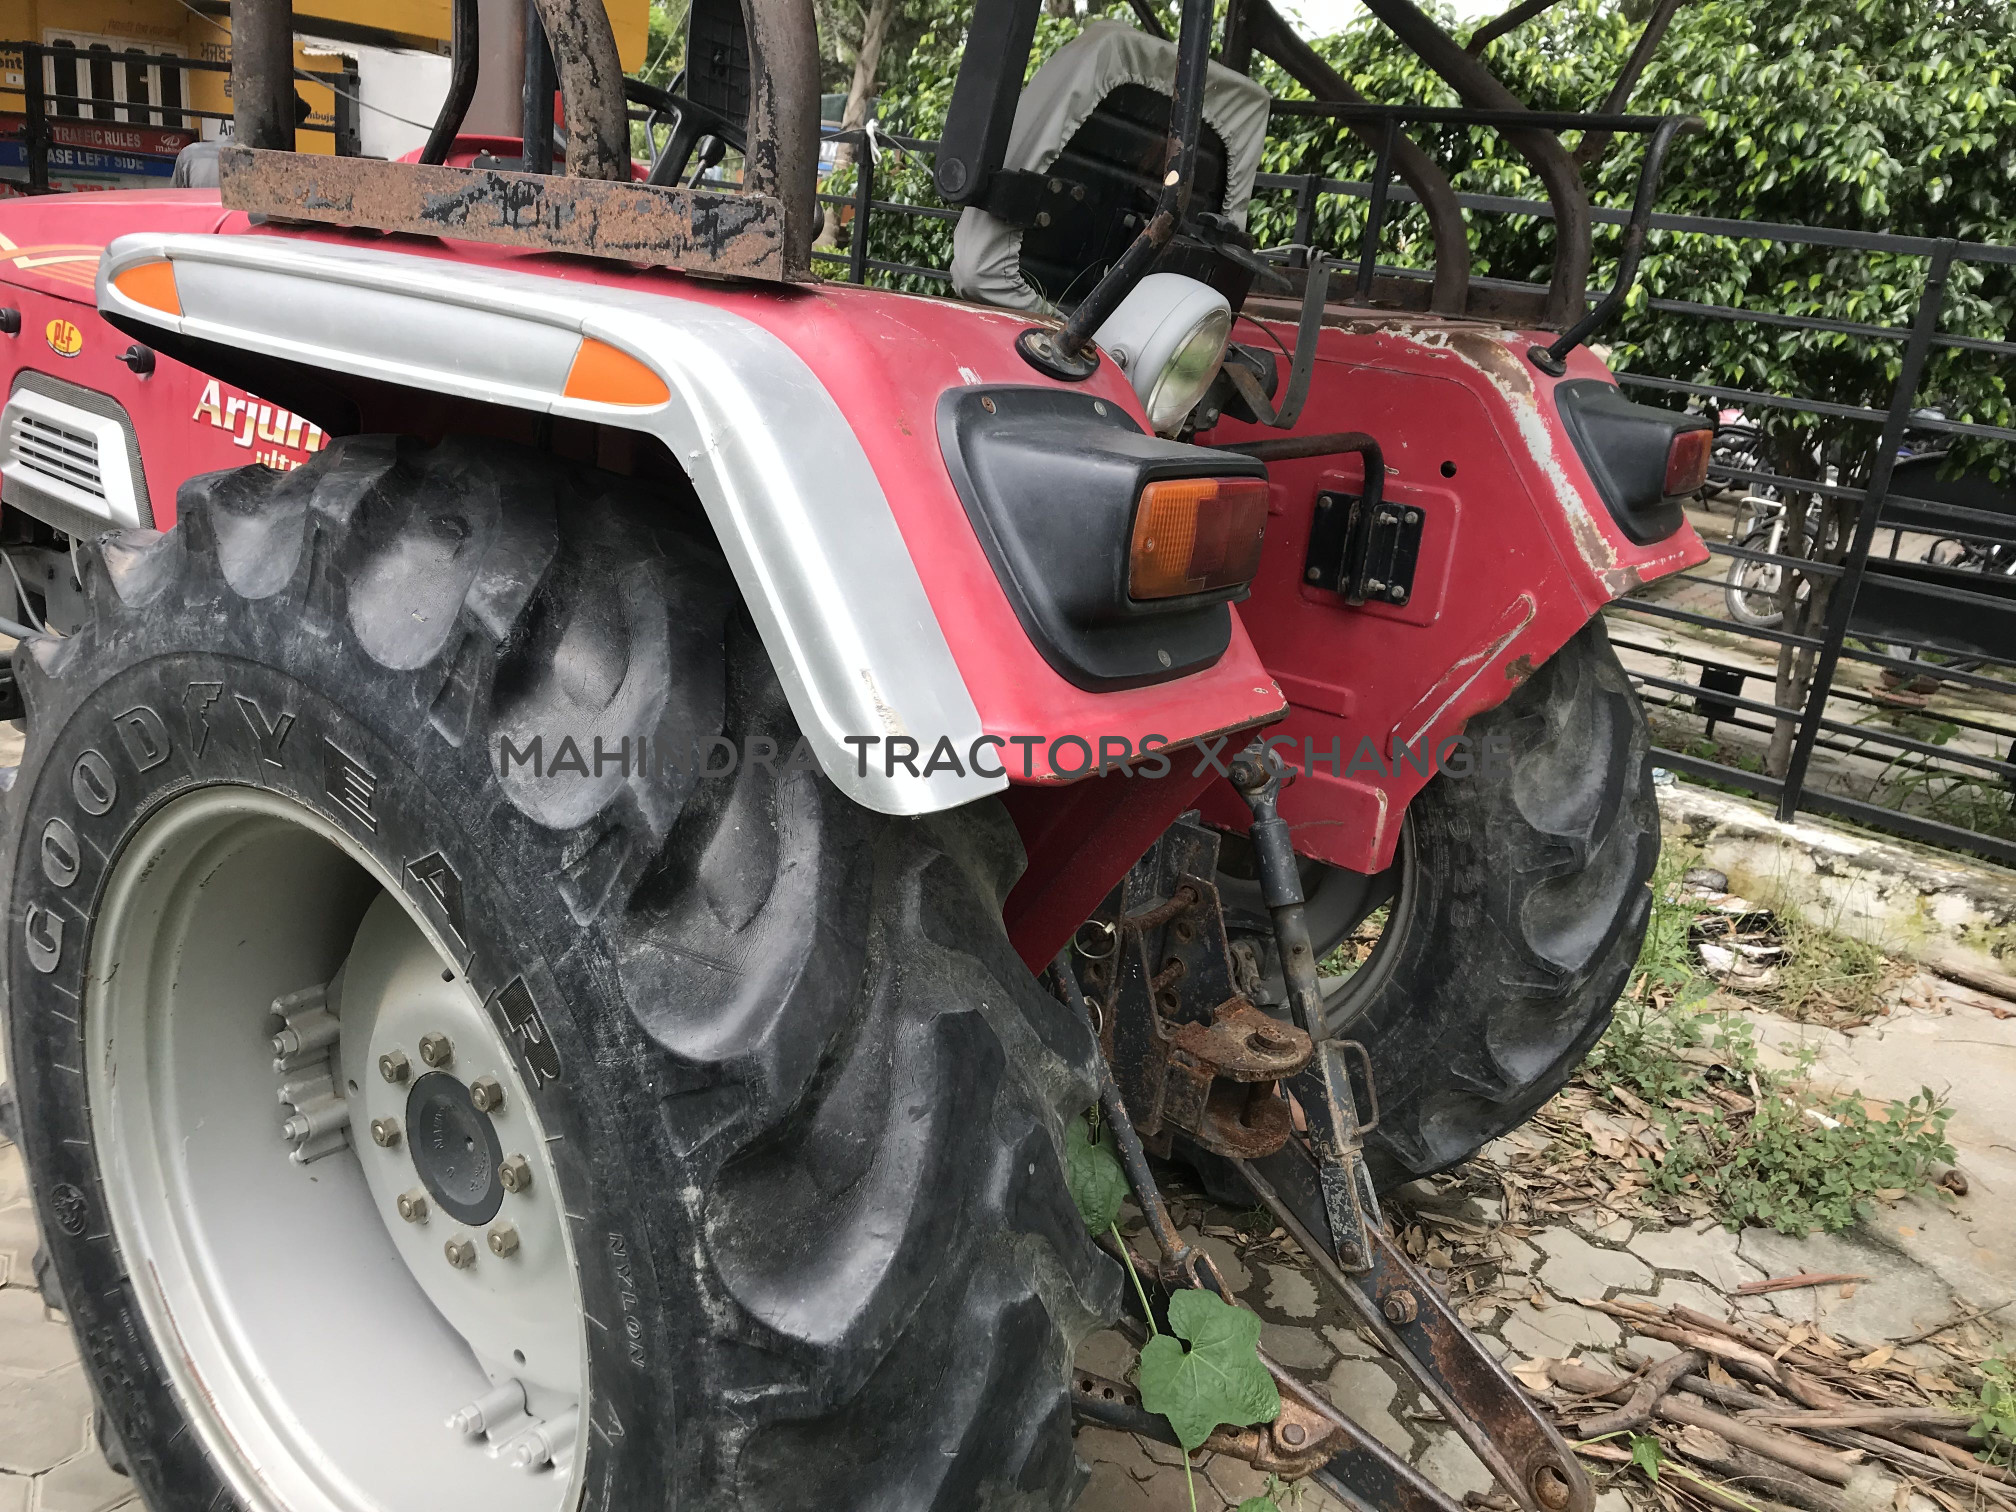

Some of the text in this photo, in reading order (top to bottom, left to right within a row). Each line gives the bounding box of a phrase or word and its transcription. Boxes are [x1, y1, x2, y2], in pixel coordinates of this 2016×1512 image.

[18, 146, 144, 170] PASE LEFT SIDE
[53, 126, 141, 148] TRAFFIC RULES
[192, 378, 323, 453] Arjun
[608, 1231, 646, 1369] NYLON
